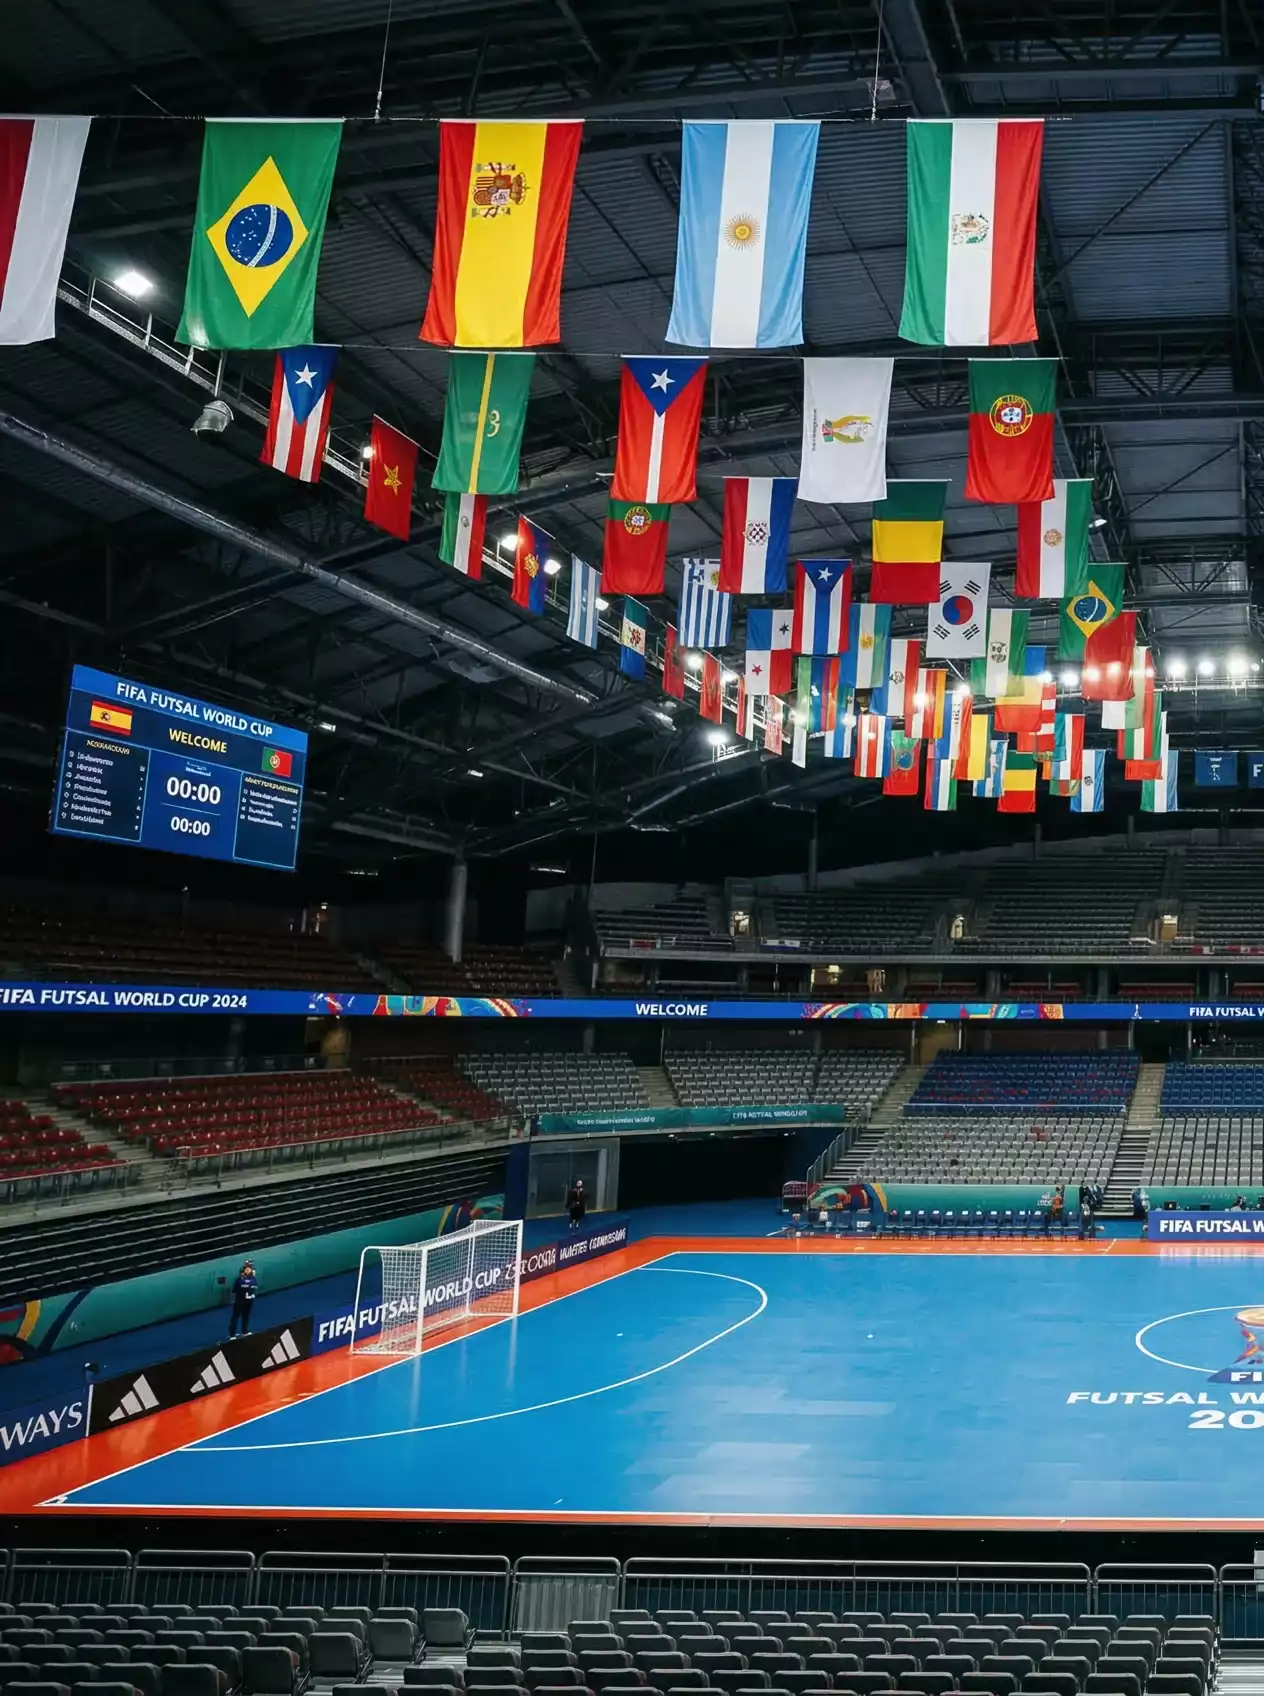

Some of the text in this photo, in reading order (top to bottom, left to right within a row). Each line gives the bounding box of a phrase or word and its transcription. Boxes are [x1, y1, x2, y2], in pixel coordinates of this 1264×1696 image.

[116, 682, 273, 738] FIFA FUTSAL WORLD CUP
[168, 728, 227, 753] WELCOME
[166, 776, 221, 804] 00:00
[170, 816, 211, 836] 00:00
[40, 989, 110, 1005] FUTSAL
[113, 991, 175, 1007] WORLD
[178, 993, 210, 1007] CUP
[211, 994, 248, 1008] 2024
[635, 1003, 708, 1016] WELCOME
[1215, 1007, 1256, 1017] FUTSAL
[1159, 1220, 1194, 1233] FIFA
[1196, 1220, 1251, 1233] FUTSAL
[318, 1313, 356, 1343] FIFA
[359, 1296, 418, 1328] FUTSAL
[422, 1277, 472, 1308] WORLD
[475, 1267, 501, 1290] CUP
[1066, 1392, 1217, 1405] FUTSAL
